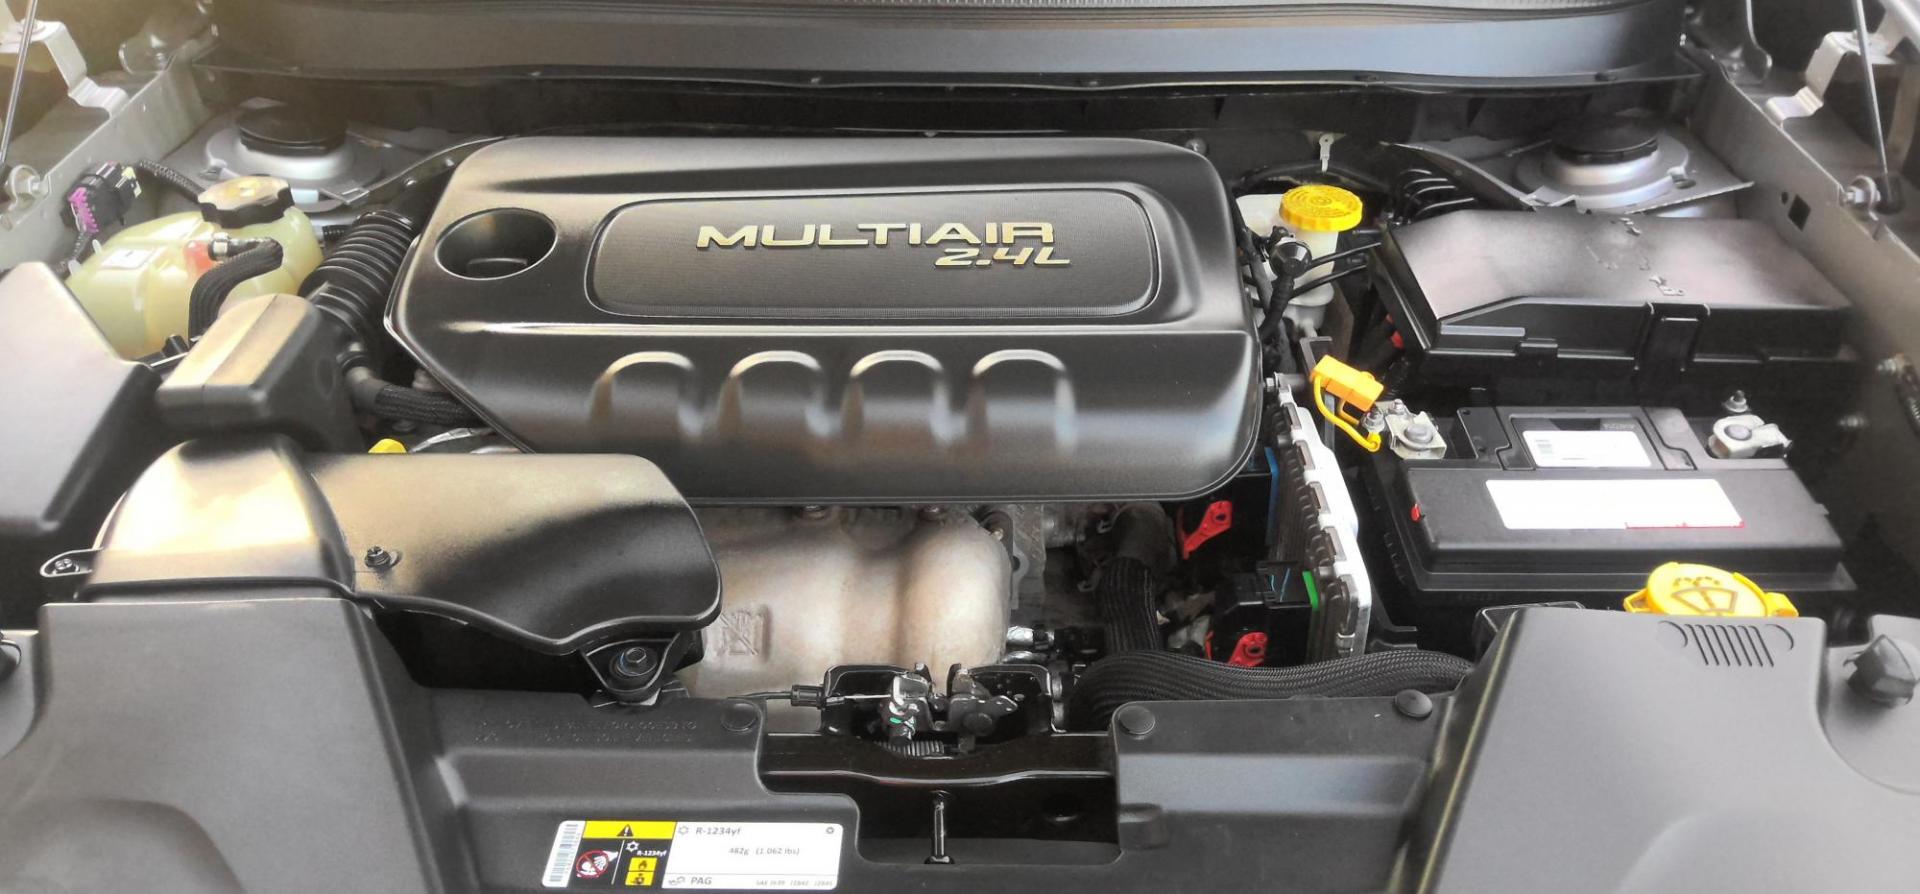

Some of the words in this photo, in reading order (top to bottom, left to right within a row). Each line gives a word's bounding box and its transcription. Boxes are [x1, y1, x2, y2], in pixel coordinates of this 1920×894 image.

[696, 222, 1056, 249] MULTIAIR
[934, 247, 1071, 267] 2.4L
[695, 826, 742, 837] R-1234yf
[690, 876, 713, 885] PAG
